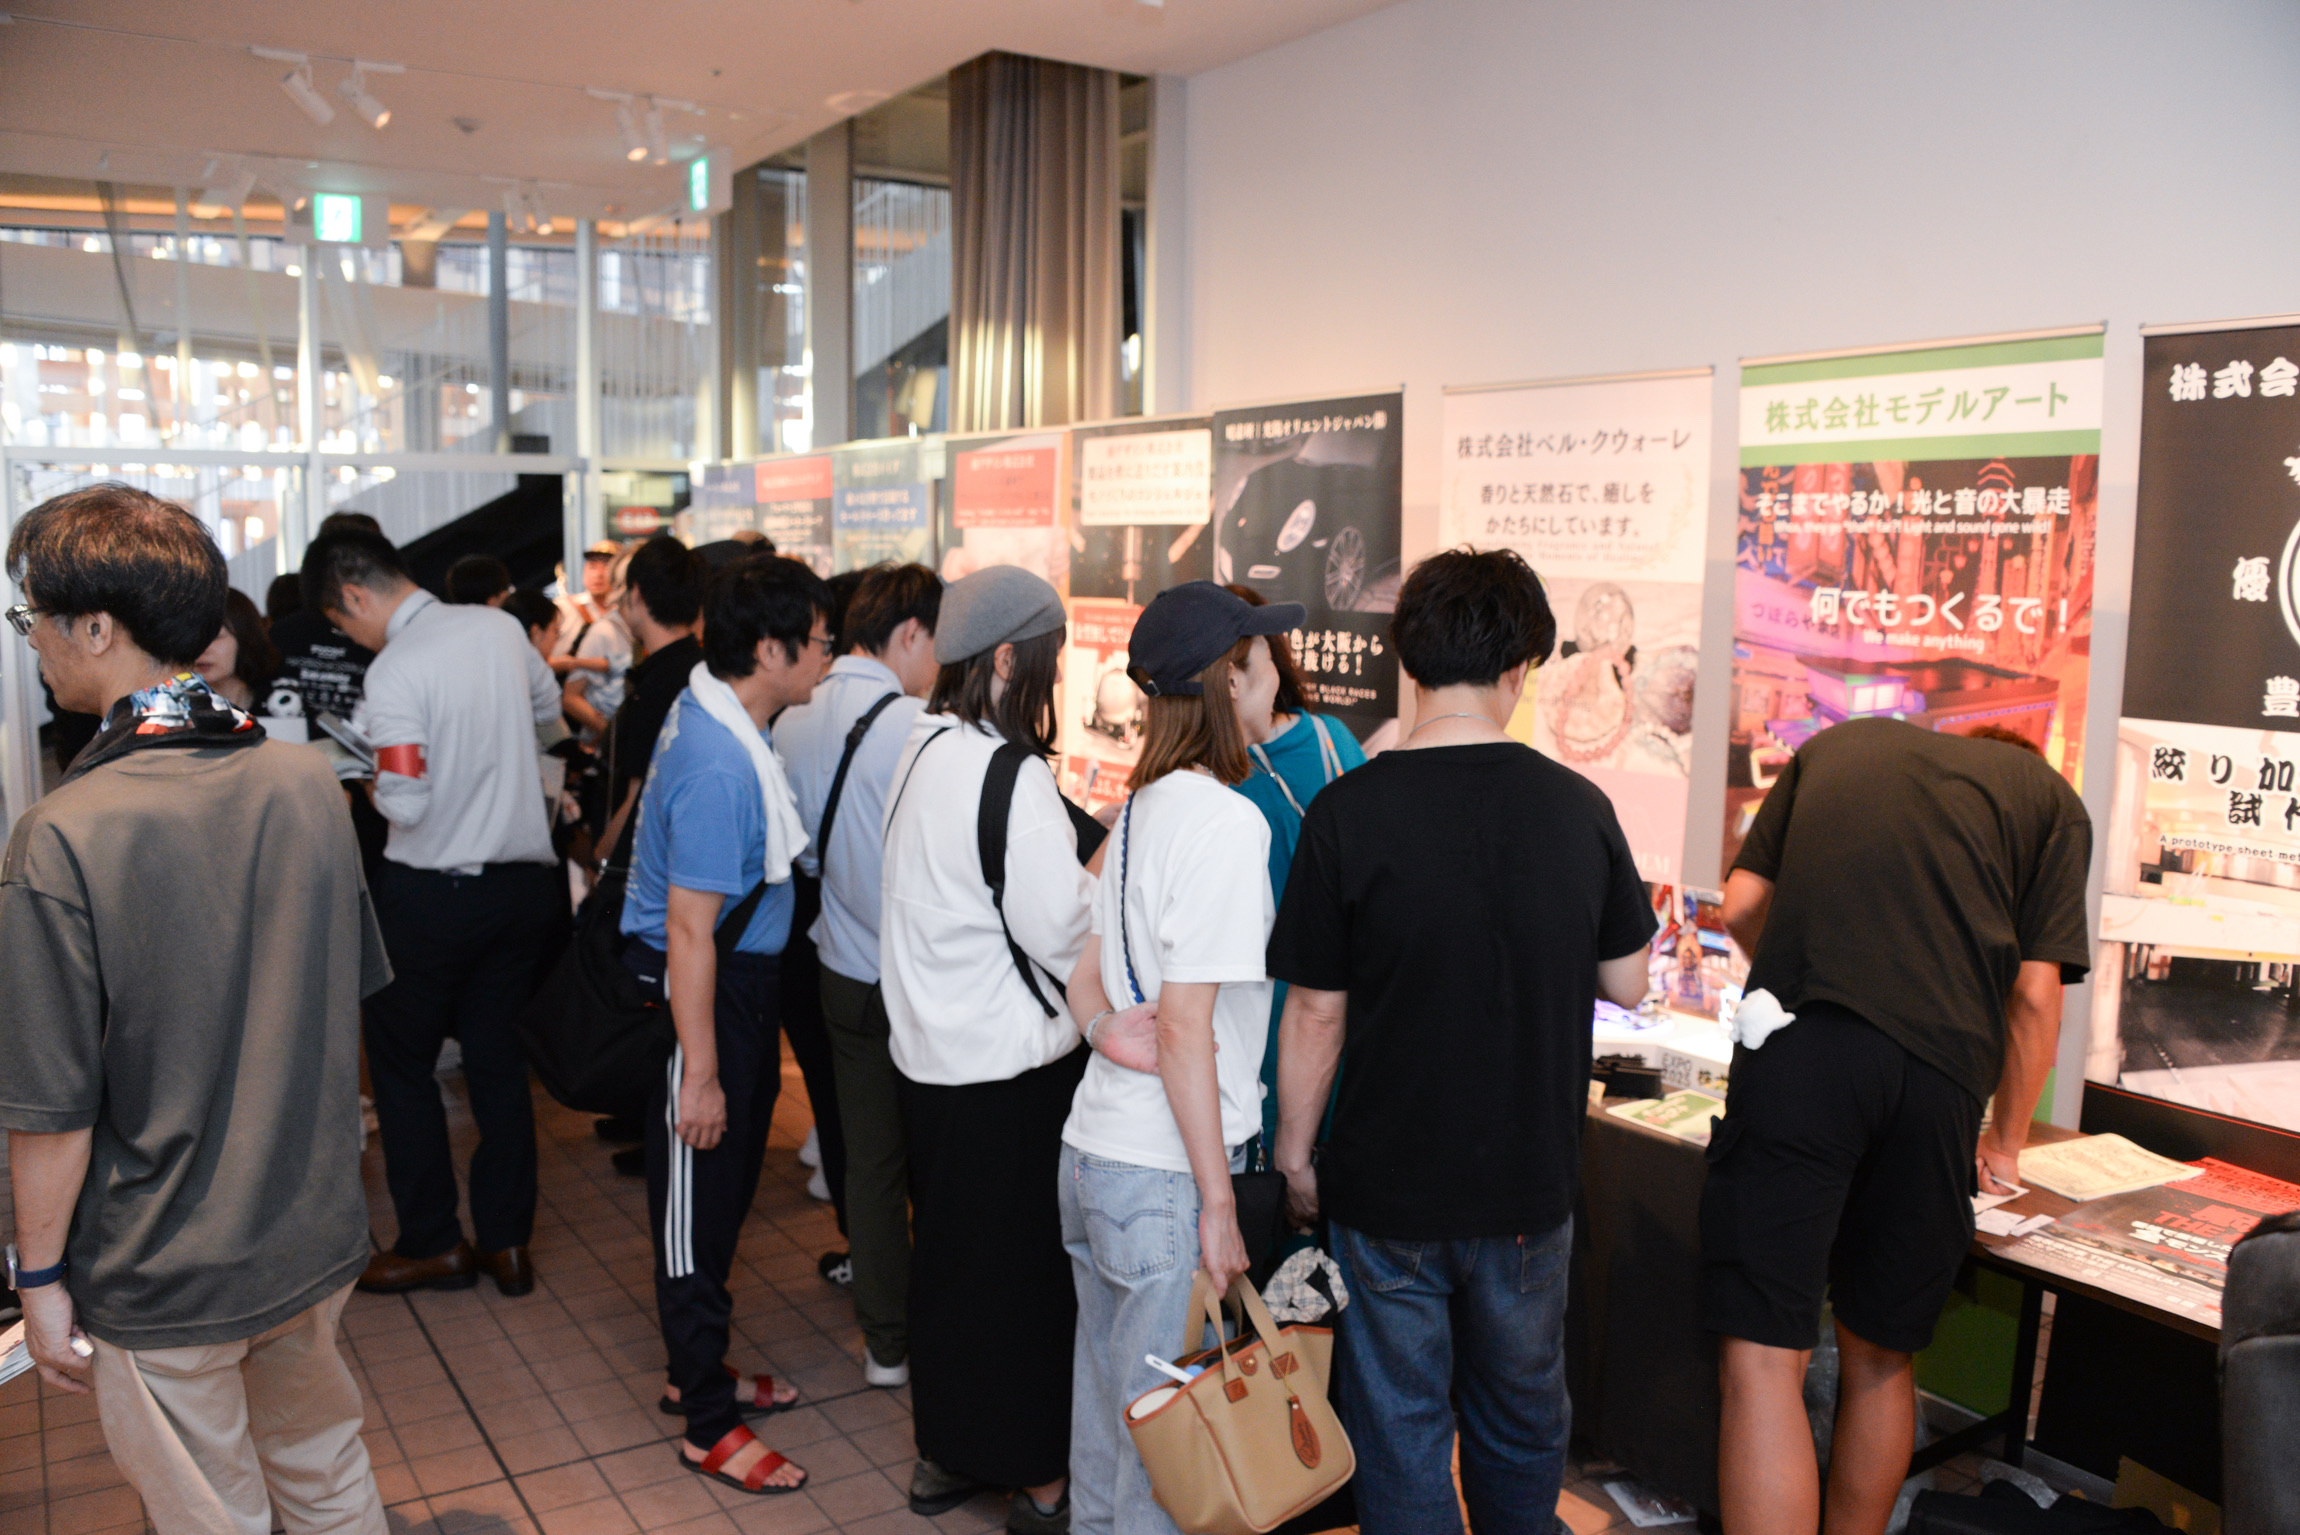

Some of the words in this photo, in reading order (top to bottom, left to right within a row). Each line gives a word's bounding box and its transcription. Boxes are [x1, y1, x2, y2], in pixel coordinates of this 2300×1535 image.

[1765, 381, 2069, 434] 株式会社モデルアート
[1457, 427, 1691, 459] 株式会社ベル・クウォーレ
[1481, 482, 1655, 505] 香りと天然石で、癒しを
[1485, 514, 1640, 538] かたちにしています。
[1903, 519, 1932, 536] Light
[1934, 519, 1956, 533] and
[1956, 519, 1990, 533] sound
[1992, 522, 2020, 537] gone
[1810, 585, 2068, 634] 何でもつくるで！
[1283, 628, 1384, 656] 色が大阪から
[1863, 629, 1884, 645] We
[1886, 631, 1921, 647] make
[1922, 633, 1985, 655] anything
[2159, 834, 2168, 844] A
[2171, 837, 2234, 852] prototype
[2237, 843, 2273, 858] sheet
[1662, 1052, 1692, 1074] EXPO
[2153, 1209, 2226, 1239] THE
